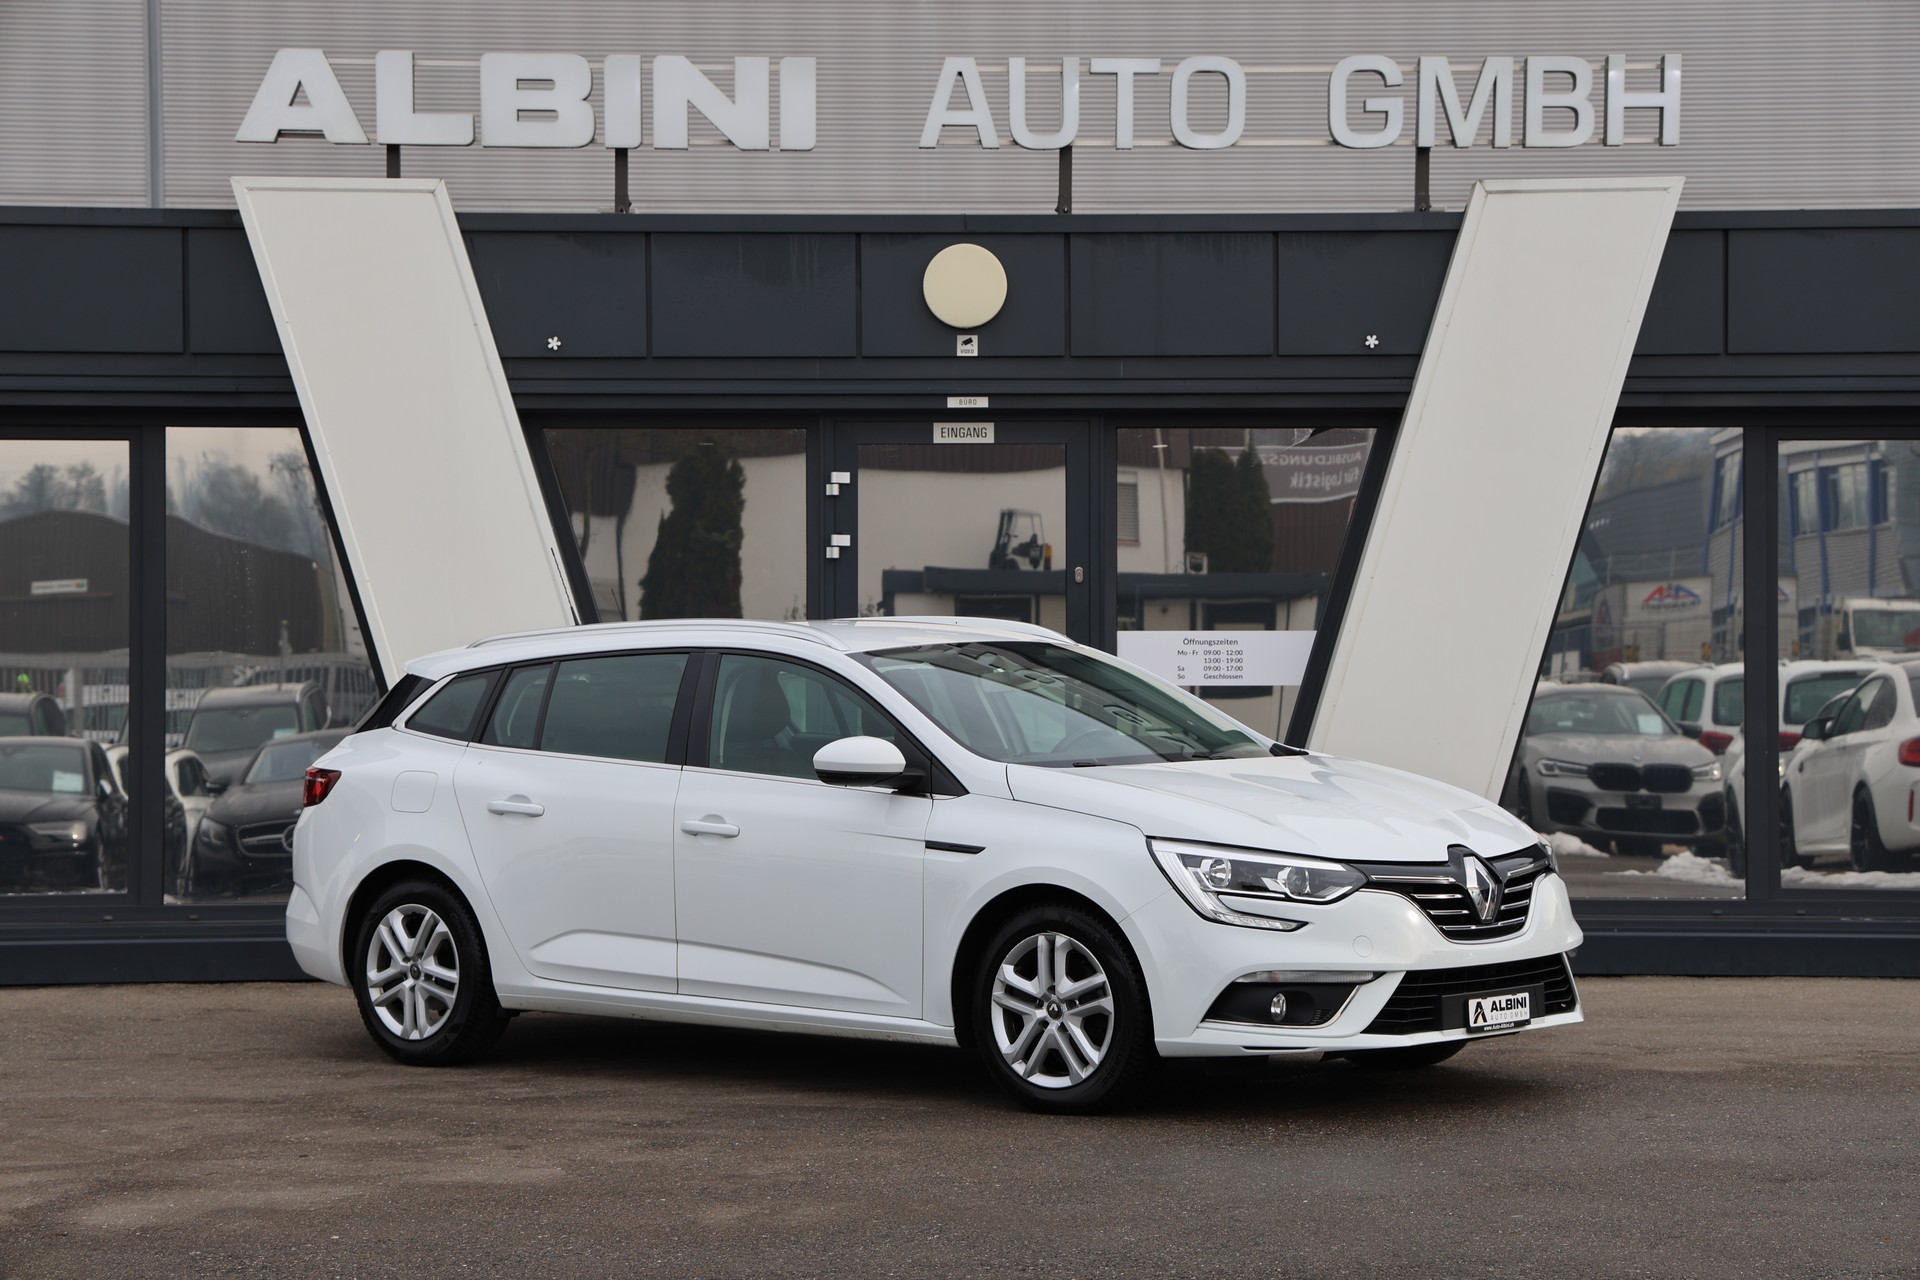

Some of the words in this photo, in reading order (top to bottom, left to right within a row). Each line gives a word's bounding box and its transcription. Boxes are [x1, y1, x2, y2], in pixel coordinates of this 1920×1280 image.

[235, 48, 816, 151] ALBINI
[919, 55, 1247, 150] AUTO
[1329, 53, 1682, 149] GMBH
[958, 397, 978, 406] BÜRO
[940, 426, 988, 439] EINGANG
[1182, 638, 1239, 646] Öffnungszeiten
[1490, 997, 1527, 1012] ALBINI
[1490, 1013, 1508, 1021] AUTO
[1510, 1011, 1528, 1019] GMBH
